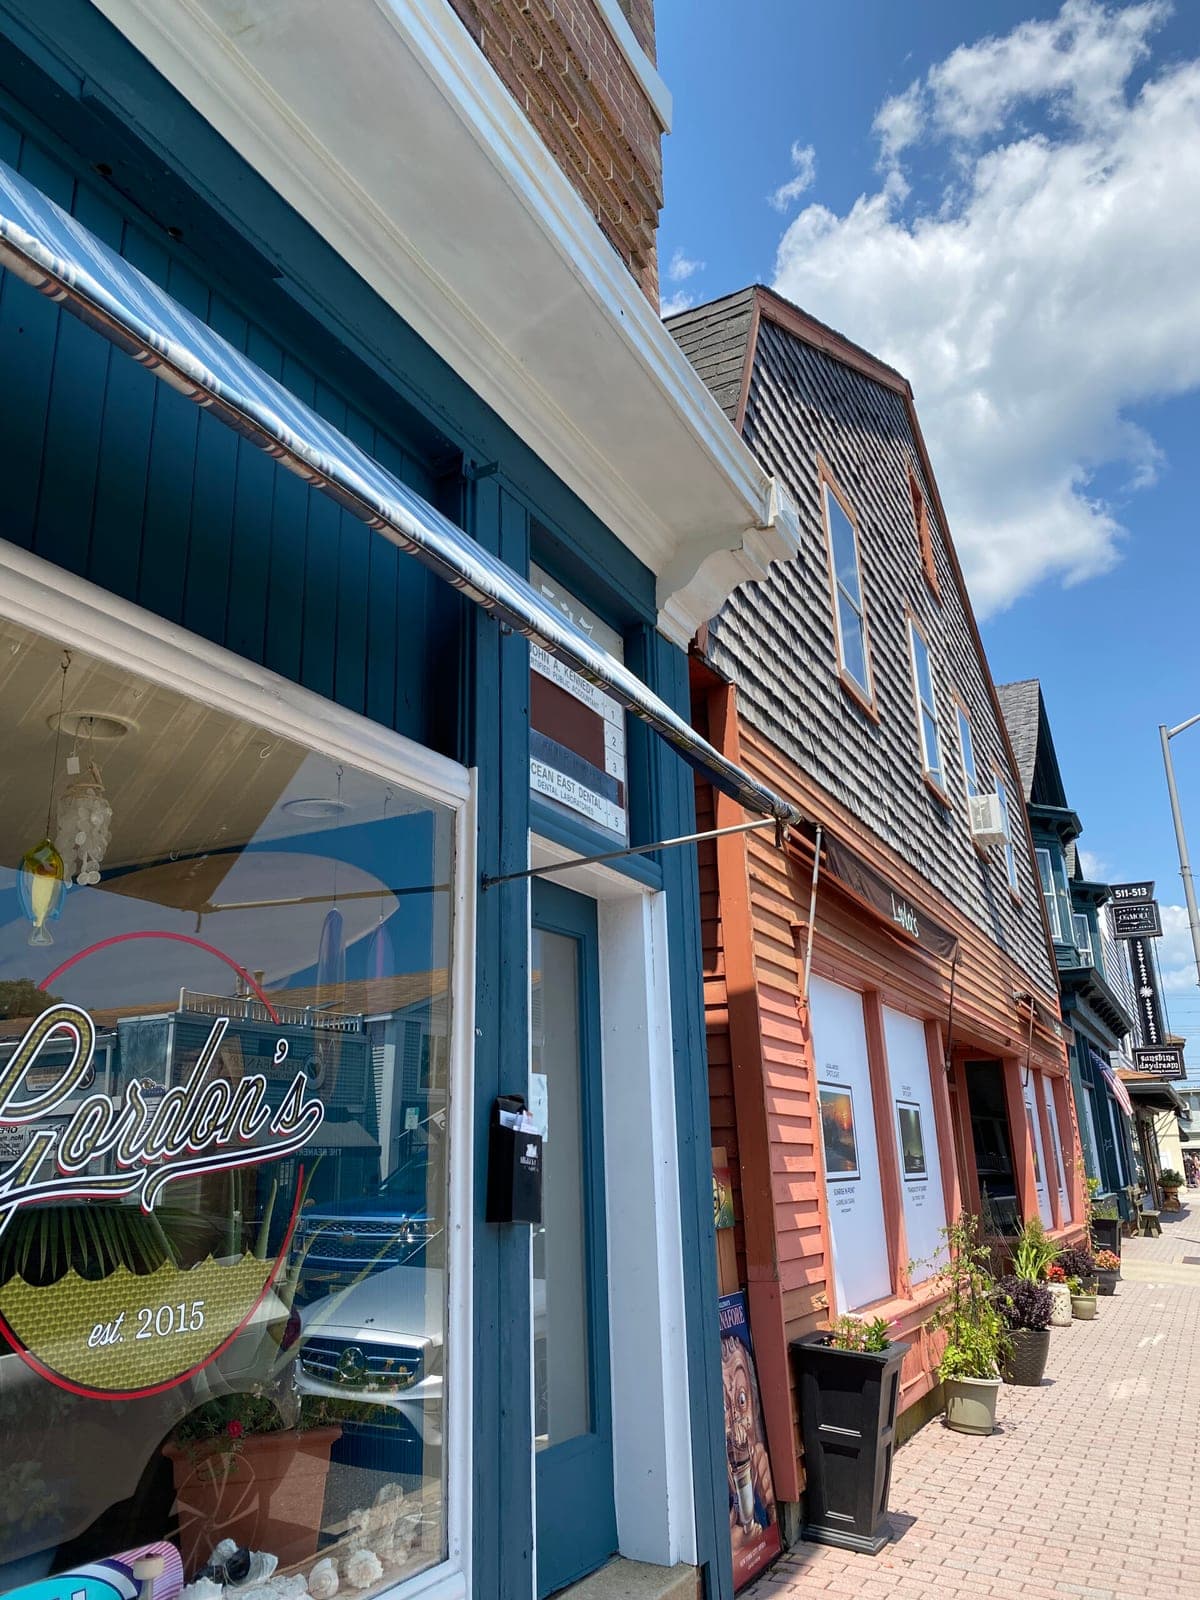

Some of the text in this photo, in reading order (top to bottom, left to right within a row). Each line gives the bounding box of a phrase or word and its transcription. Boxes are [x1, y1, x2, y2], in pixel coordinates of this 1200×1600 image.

[530, 655, 551, 675] RTIFIED
[530, 644, 550, 666] OHN
[564, 667, 595, 697] KENNEDY
[611, 710, 615, 720] 1
[611, 736, 617, 747] 2
[612, 762, 617, 773] 3
[530, 762, 602, 811] CEAN EAST DENTAL
[537, 779, 559, 796] DENTAL
[614, 816, 619, 828] 5
[1115, 887, 1148, 898] 511-513
[1139, 1061, 1179, 1071] daydream
[87, 1300, 205, 1348] est. 2015
[719, 1305, 745, 1331] NAFORE
